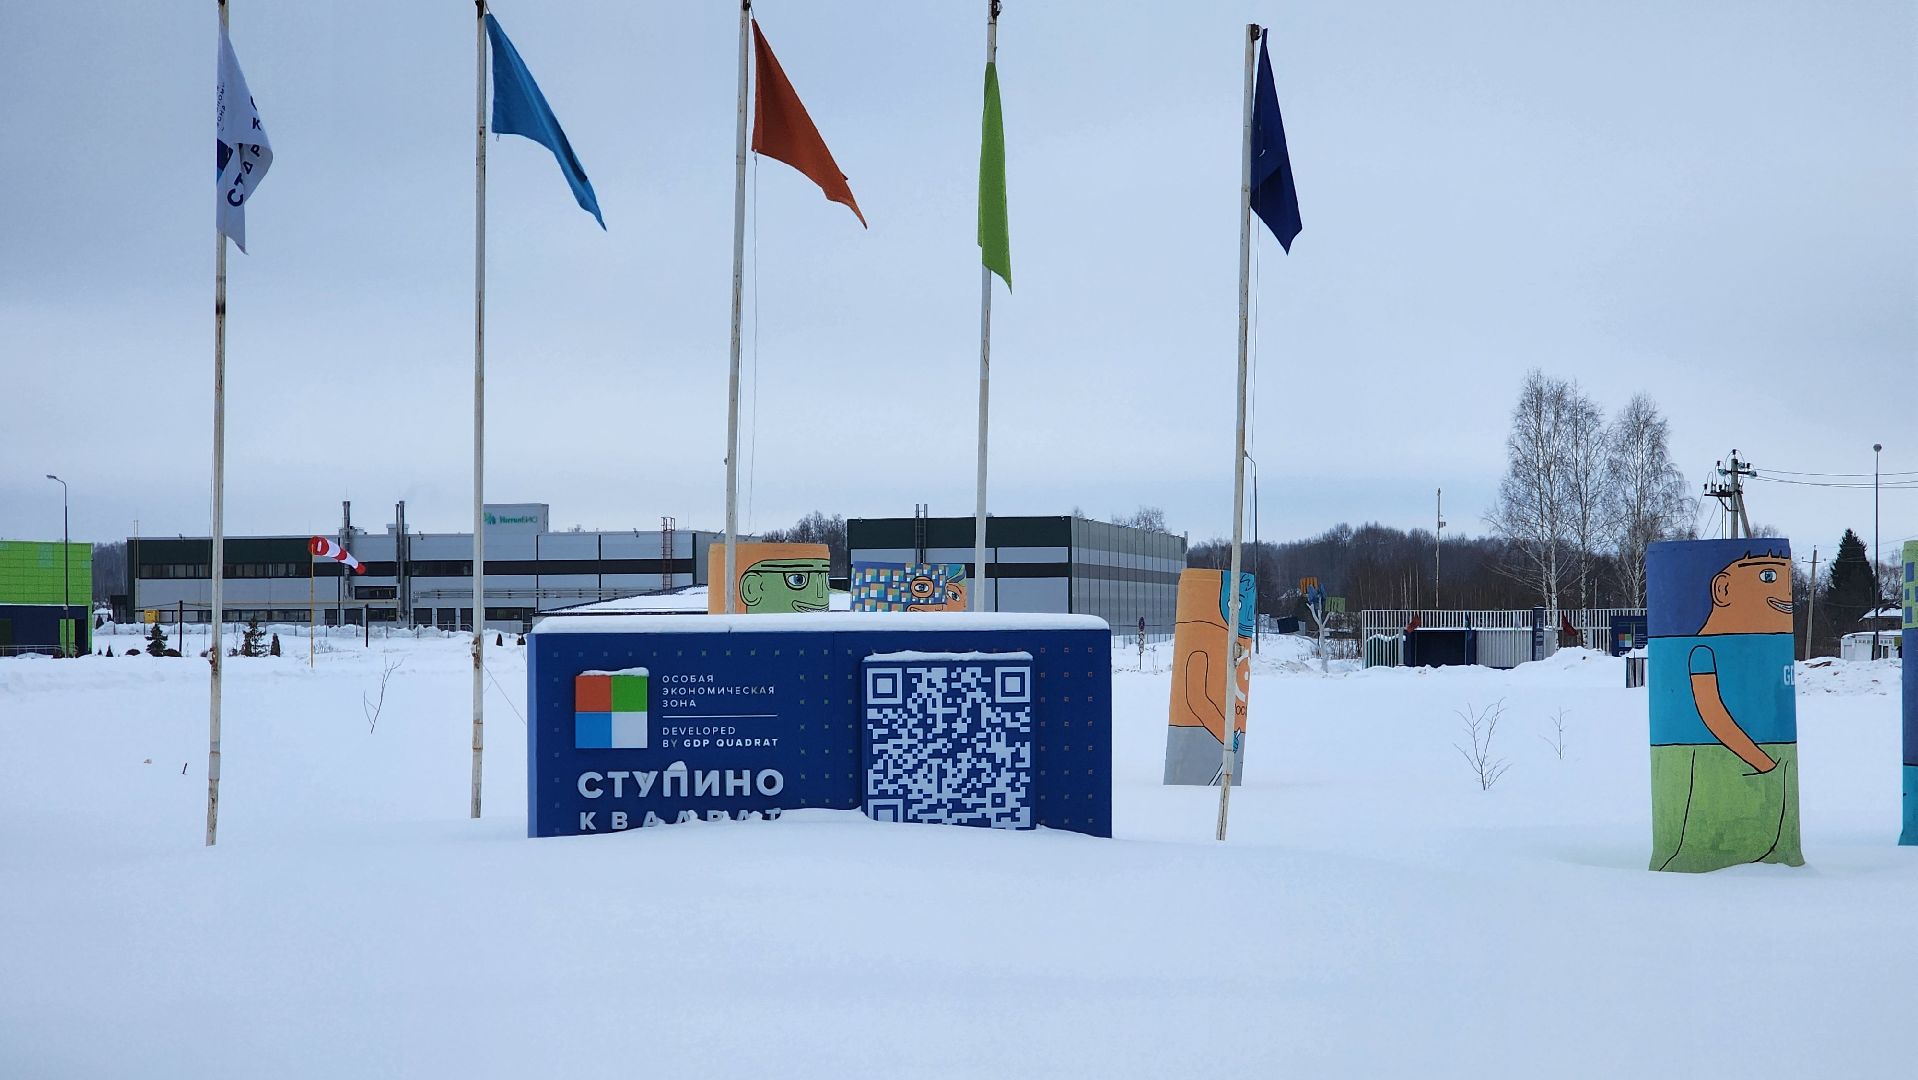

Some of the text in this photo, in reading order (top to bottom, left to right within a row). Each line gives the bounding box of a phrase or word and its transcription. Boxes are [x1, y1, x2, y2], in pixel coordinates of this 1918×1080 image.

[662, 674, 714, 683] ОСОБАЯ
[662, 686, 775, 695] ЭКОНОМИЧЕСКАЯ
[662, 699, 697, 708] ЗОНА
[662, 726, 736, 736] DEVELOPED
[662, 737, 779, 748] BY GDP QUADRAT
[577, 768, 784, 799] СТУПИНО
